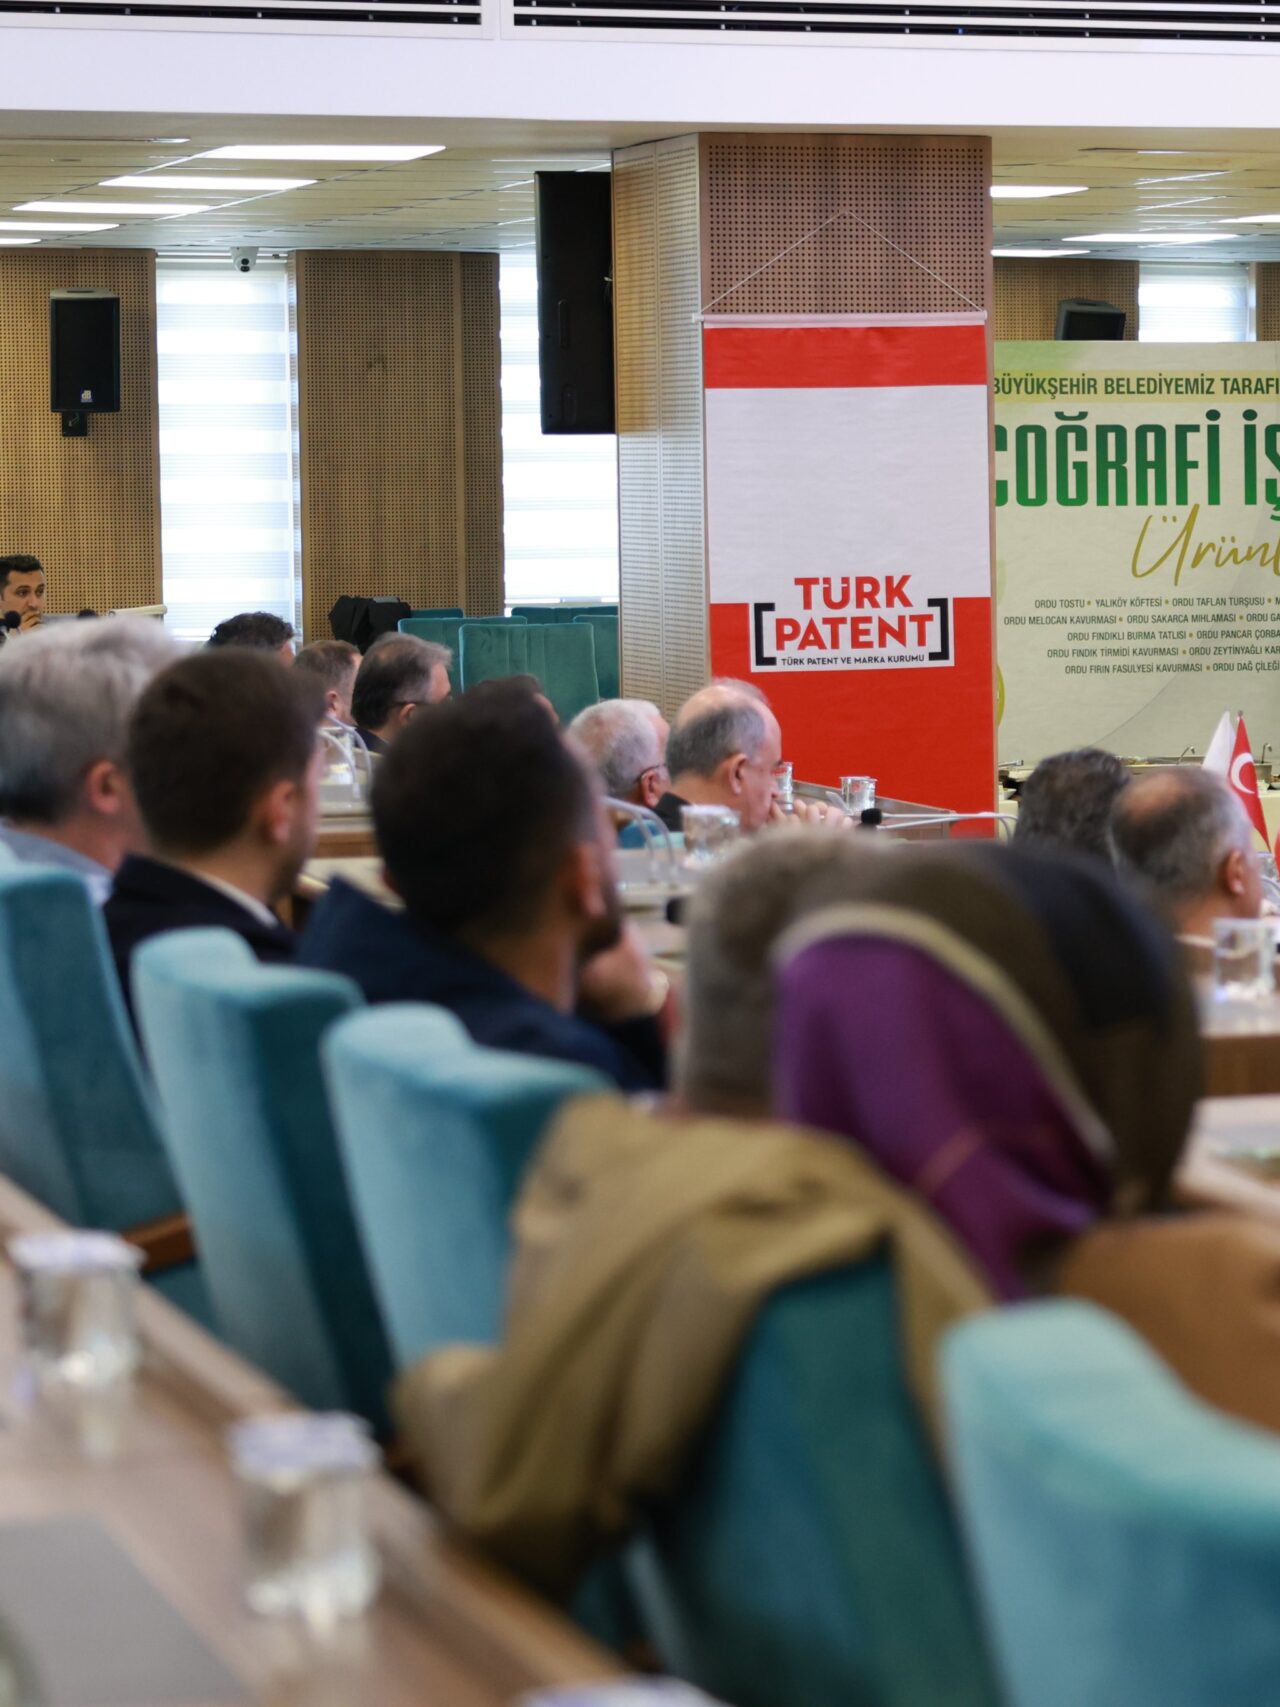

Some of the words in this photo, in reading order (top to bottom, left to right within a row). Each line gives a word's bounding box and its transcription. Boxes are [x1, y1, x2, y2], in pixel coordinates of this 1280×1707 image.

[1104, 373, 1215, 394] BELEDİYEMİZ
[794, 574, 913, 610] TÜRK
[1034, 600, 1057, 608] ORDU
[1060, 599, 1085, 608] TOSTU
[1095, 598, 1127, 608] YALIKÖY
[1130, 597, 1162, 607] KÖFTESİ
[1172, 598, 1194, 606] ORDU
[1196, 597, 1226, 606] TAFLAN
[1229, 597, 1265, 608] TURŞUSU
[1004, 616, 1026, 625] ORDU
[1029, 616, 1067, 625] MELOCAN
[1070, 615, 1116, 624] KAVURMASI
[1127, 615, 1149, 624] ORDU
[1151, 614, 1189, 623] SAKARCA
[1191, 613, 1236, 622] MIHLAMASI
[1246, 613, 1268, 622] ORDU
[775, 613, 934, 651] PATENT
[1067, 632, 1089, 641] ORDU
[1092, 632, 1124, 641] FINDIKLI
[1127, 631, 1156, 640] BURMA
[1158, 630, 1186, 640] TATLISI
[1196, 630, 1218, 639] ORDU
[1220, 630, 1252, 639] PANCAR
[1047, 649, 1069, 658] ORDU
[1072, 648, 1098, 657] FINDIK
[1100, 646, 1130, 657] TİRMİDİ
[1132, 647, 1179, 656] KAVURMASI
[1189, 647, 1211, 656] ORDU
[1213, 644, 1262, 655] ZEYTİNYAĞLI
[781, 657, 805, 666] TÜRK
[807, 656, 838, 665] PATENT
[841, 656, 852, 664] VE
[854, 655, 885, 664] MARKA
[887, 654, 925, 663] KURUMU
[1065, 665, 1087, 674] ORDU
[1089, 665, 1110, 673] FIRIN
[1112, 663, 1154, 673] FASULYESİ
[1156, 663, 1202, 672] KAVURMASI
[1212, 663, 1235, 672] ORDU
[1237, 660, 1253, 671] DAĞ
[1255, 660, 1280, 672] ÇİLEĞİ
